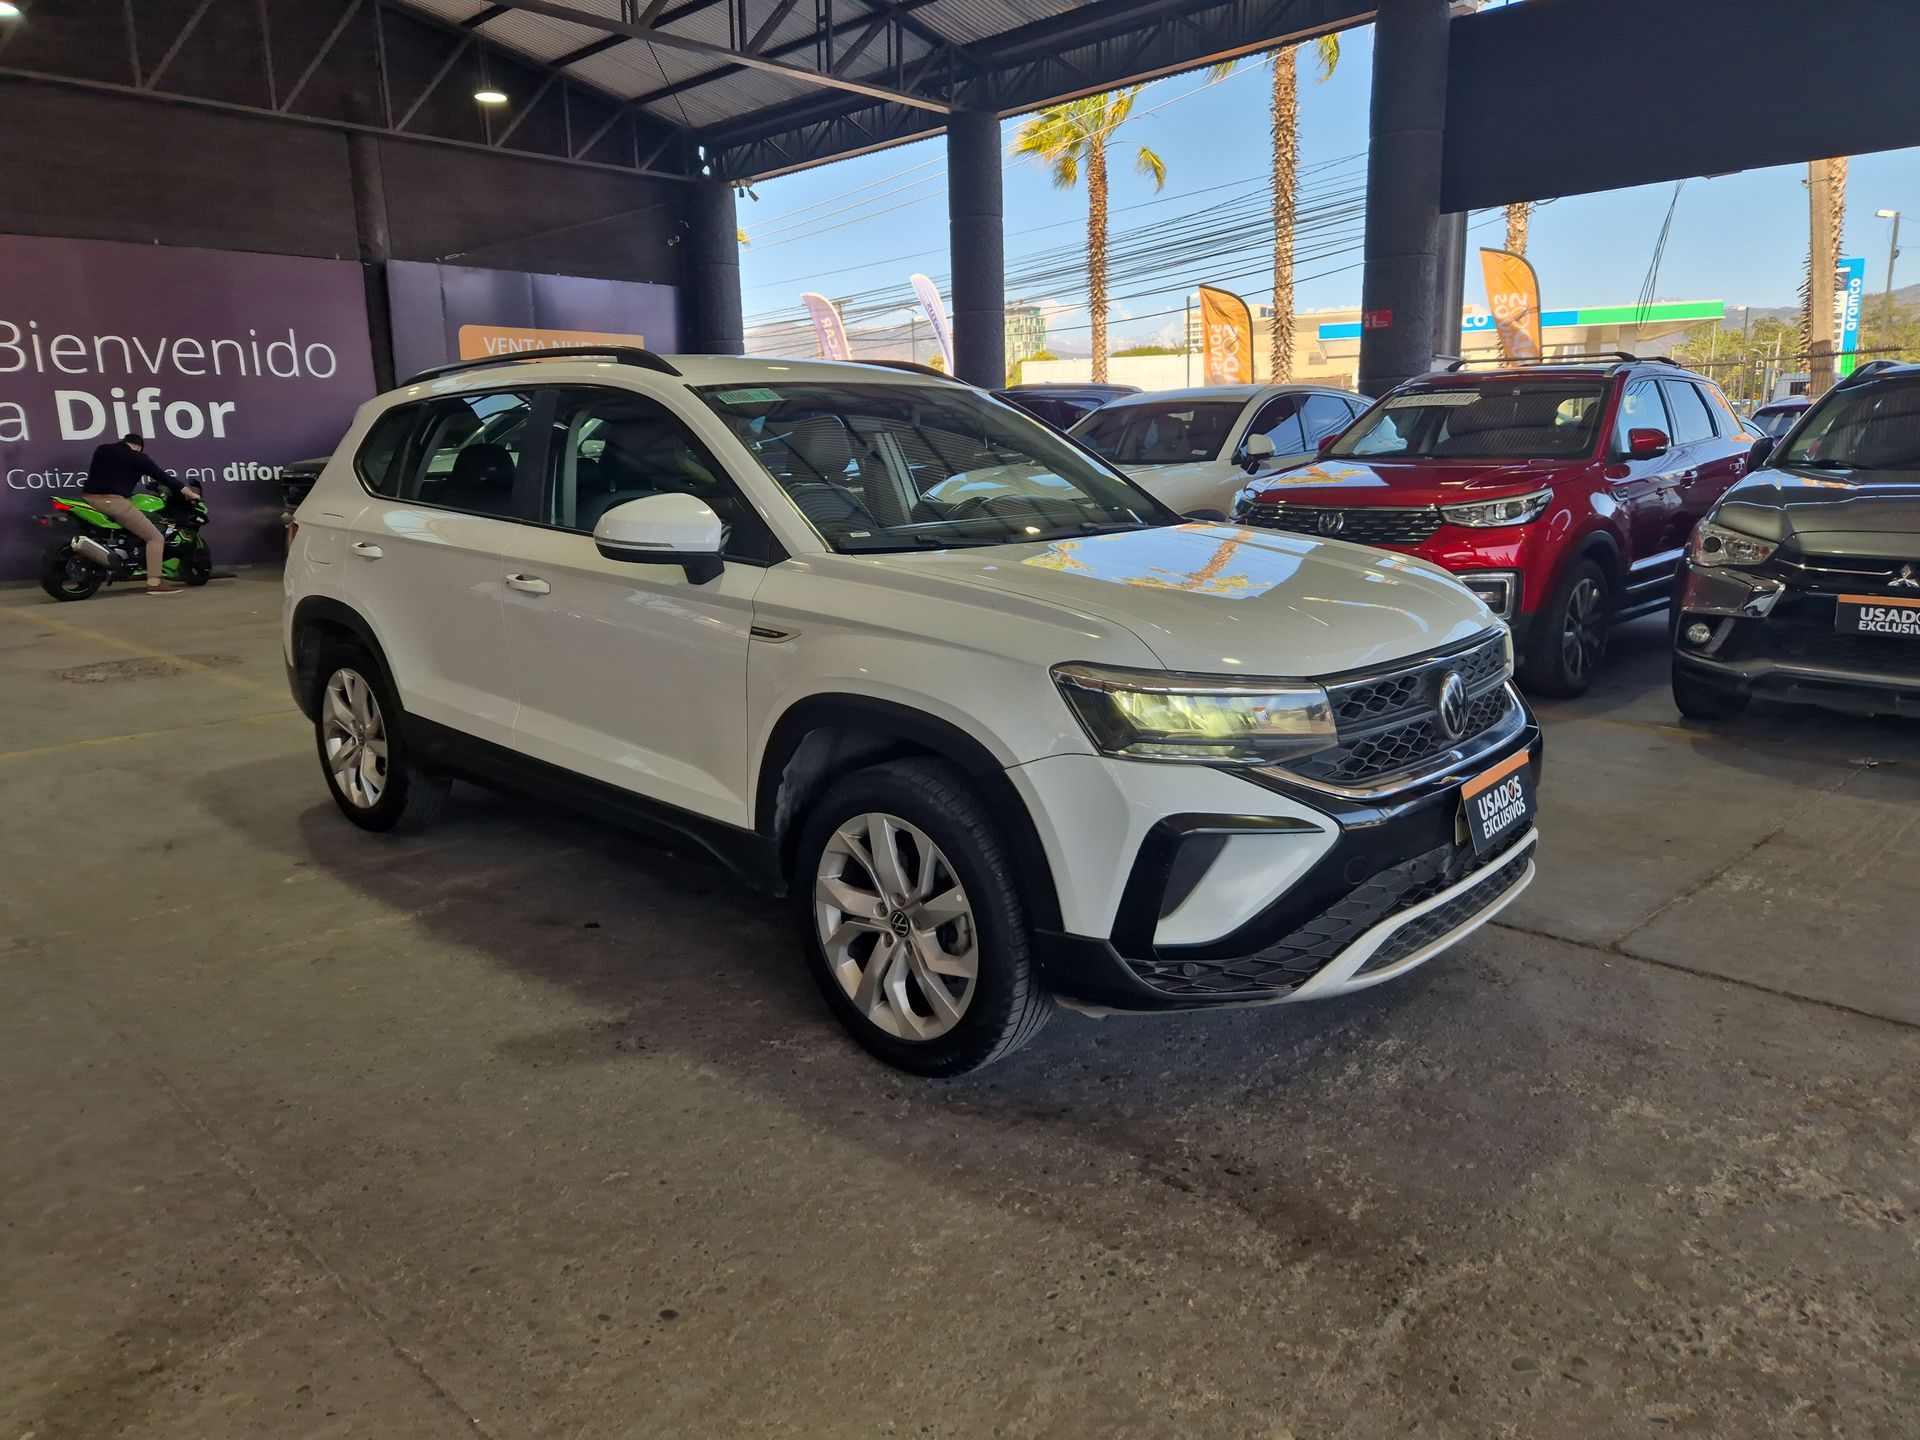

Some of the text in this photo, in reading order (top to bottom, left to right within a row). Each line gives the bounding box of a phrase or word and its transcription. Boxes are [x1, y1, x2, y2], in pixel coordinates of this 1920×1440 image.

[1846, 277, 1861, 331] aramco
[0, 319, 337, 379] Bienvenido
[483, 336, 545, 355] VENTA
[0, 386, 236, 442] a Difor
[6, 467, 88, 490] Cotiza
[185, 467, 216, 482] en
[1858, 620, 1920, 635] EXCLUSIV
[1860, 607, 1920, 625] USAD
[1477, 775, 1522, 821] USADOS
[1482, 797, 1526, 839] EXCLUSIVOS
